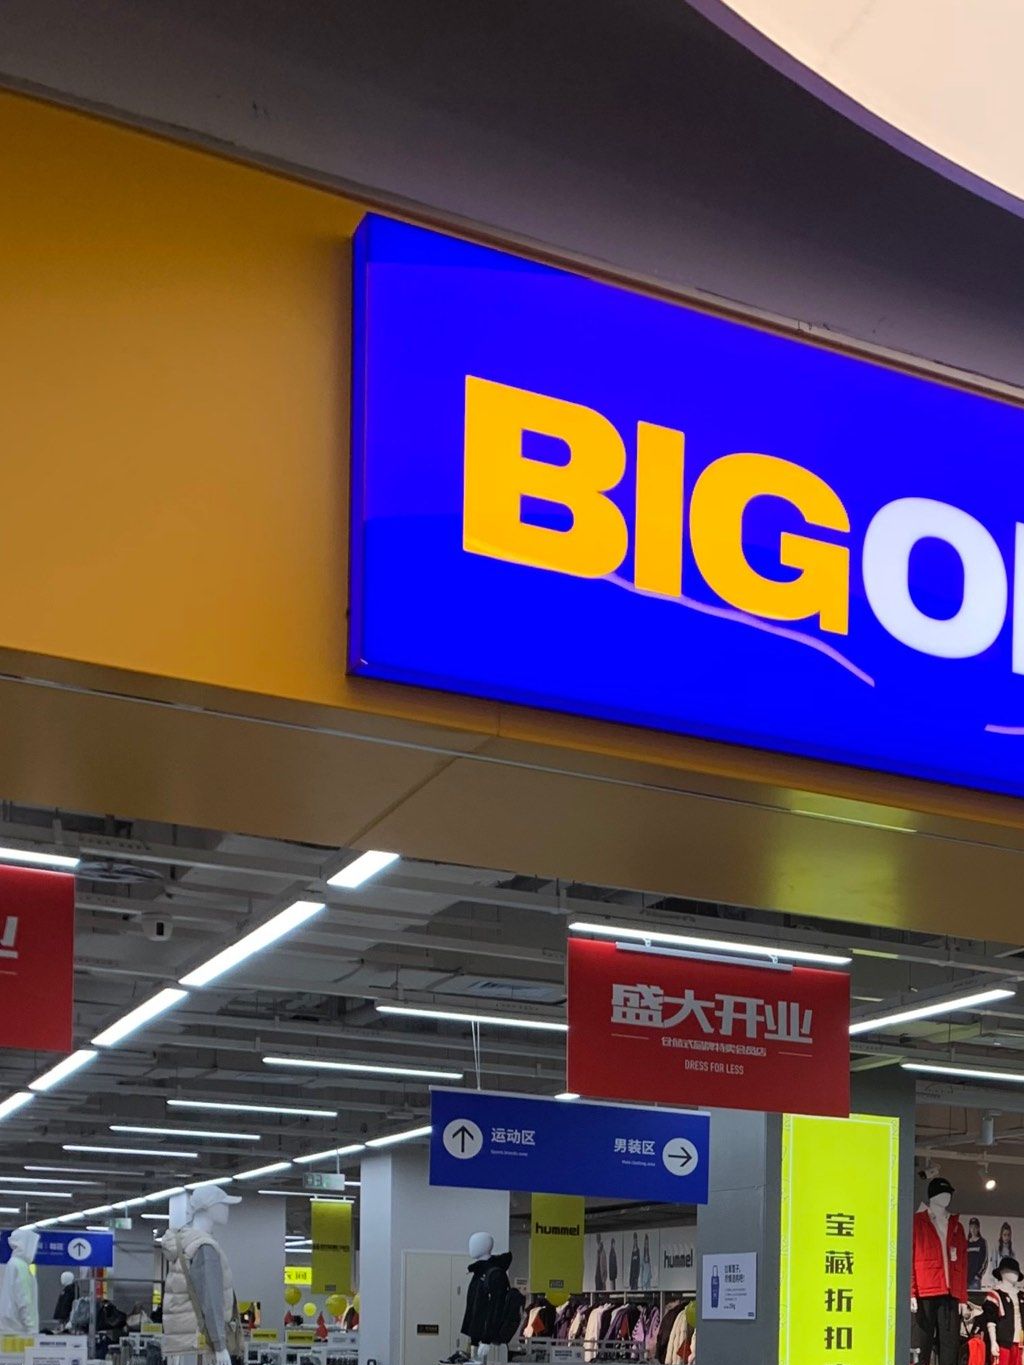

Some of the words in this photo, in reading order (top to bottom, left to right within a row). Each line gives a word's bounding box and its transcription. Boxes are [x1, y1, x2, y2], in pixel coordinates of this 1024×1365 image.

[611, 983, 813, 1044] 盛大开业
[684, 1060, 709, 1072] DRESS
[710, 1062, 725, 1073] FOR
[726, 1064, 744, 1075] LESS
[491, 1127, 536, 1146] 运动区
[614, 1138, 656, 1156] 男装区
[535, 1222, 580, 1236] hummel
[664, 1249, 693, 1268] hummel
